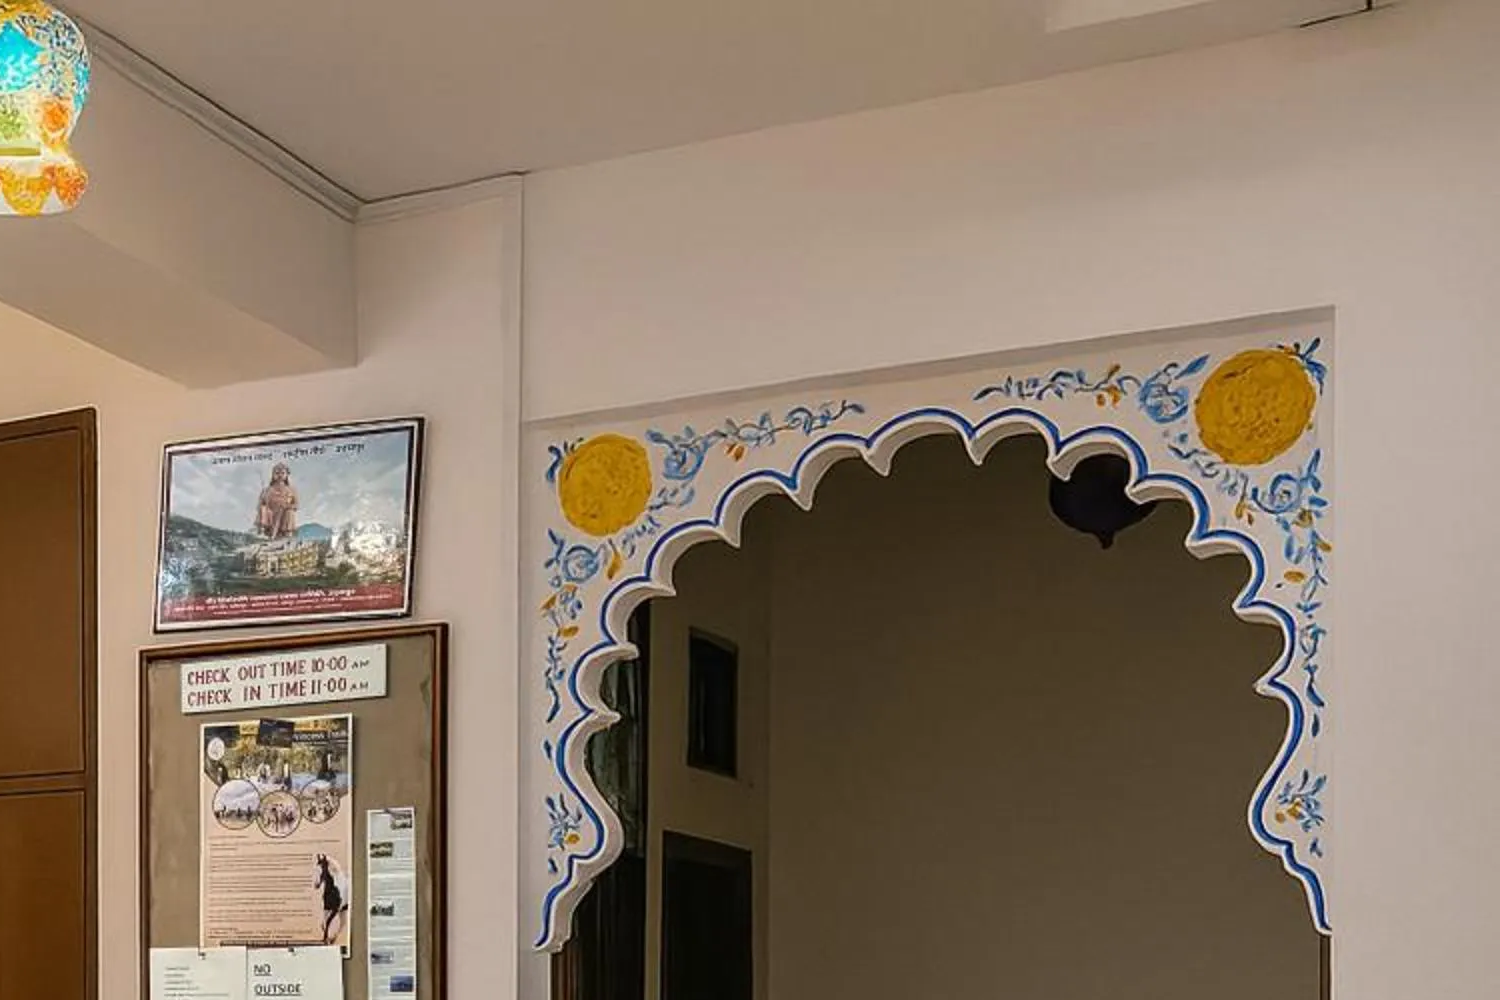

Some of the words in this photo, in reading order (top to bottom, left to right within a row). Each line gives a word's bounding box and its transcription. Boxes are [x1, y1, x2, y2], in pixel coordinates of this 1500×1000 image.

[187, 667, 230, 685] CHECK
[237, 663, 267, 681] OUT
[269, 659, 306, 678] TIME
[187, 687, 232, 707] CHECK
[243, 685, 261, 701] IN
[268, 679, 307, 699] TIME
[253, 963, 271, 976] NO
[254, 983, 302, 996] OUTSIDE
